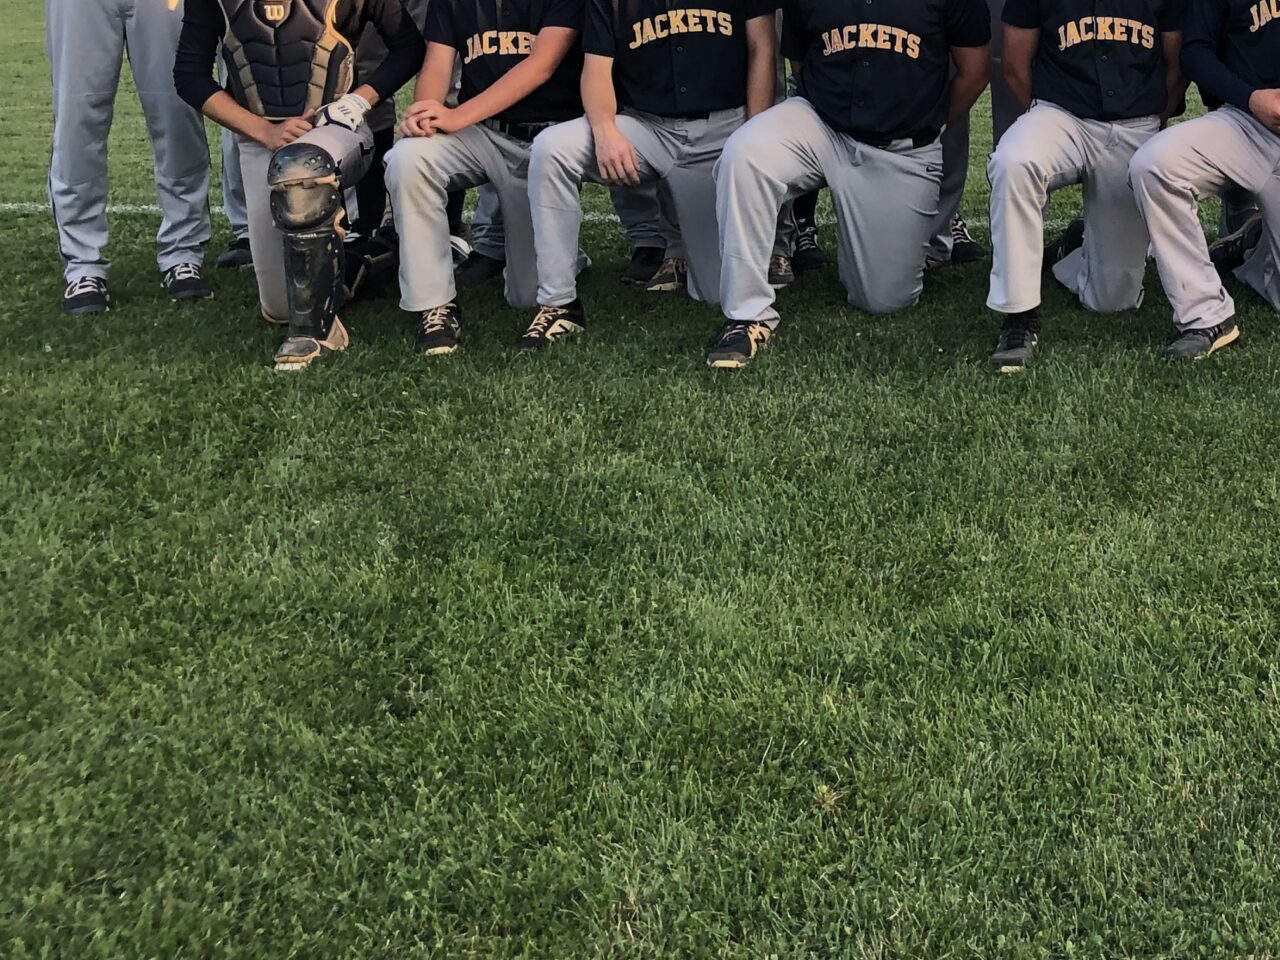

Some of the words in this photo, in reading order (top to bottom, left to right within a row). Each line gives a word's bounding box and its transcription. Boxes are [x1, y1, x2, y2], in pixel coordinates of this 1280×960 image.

[629, 8, 733, 49] JACKETS
[822, 23, 921, 59] JACKETS
[1057, 16, 1154, 50] JACKETS
[464, 30, 537, 64] JACKE
